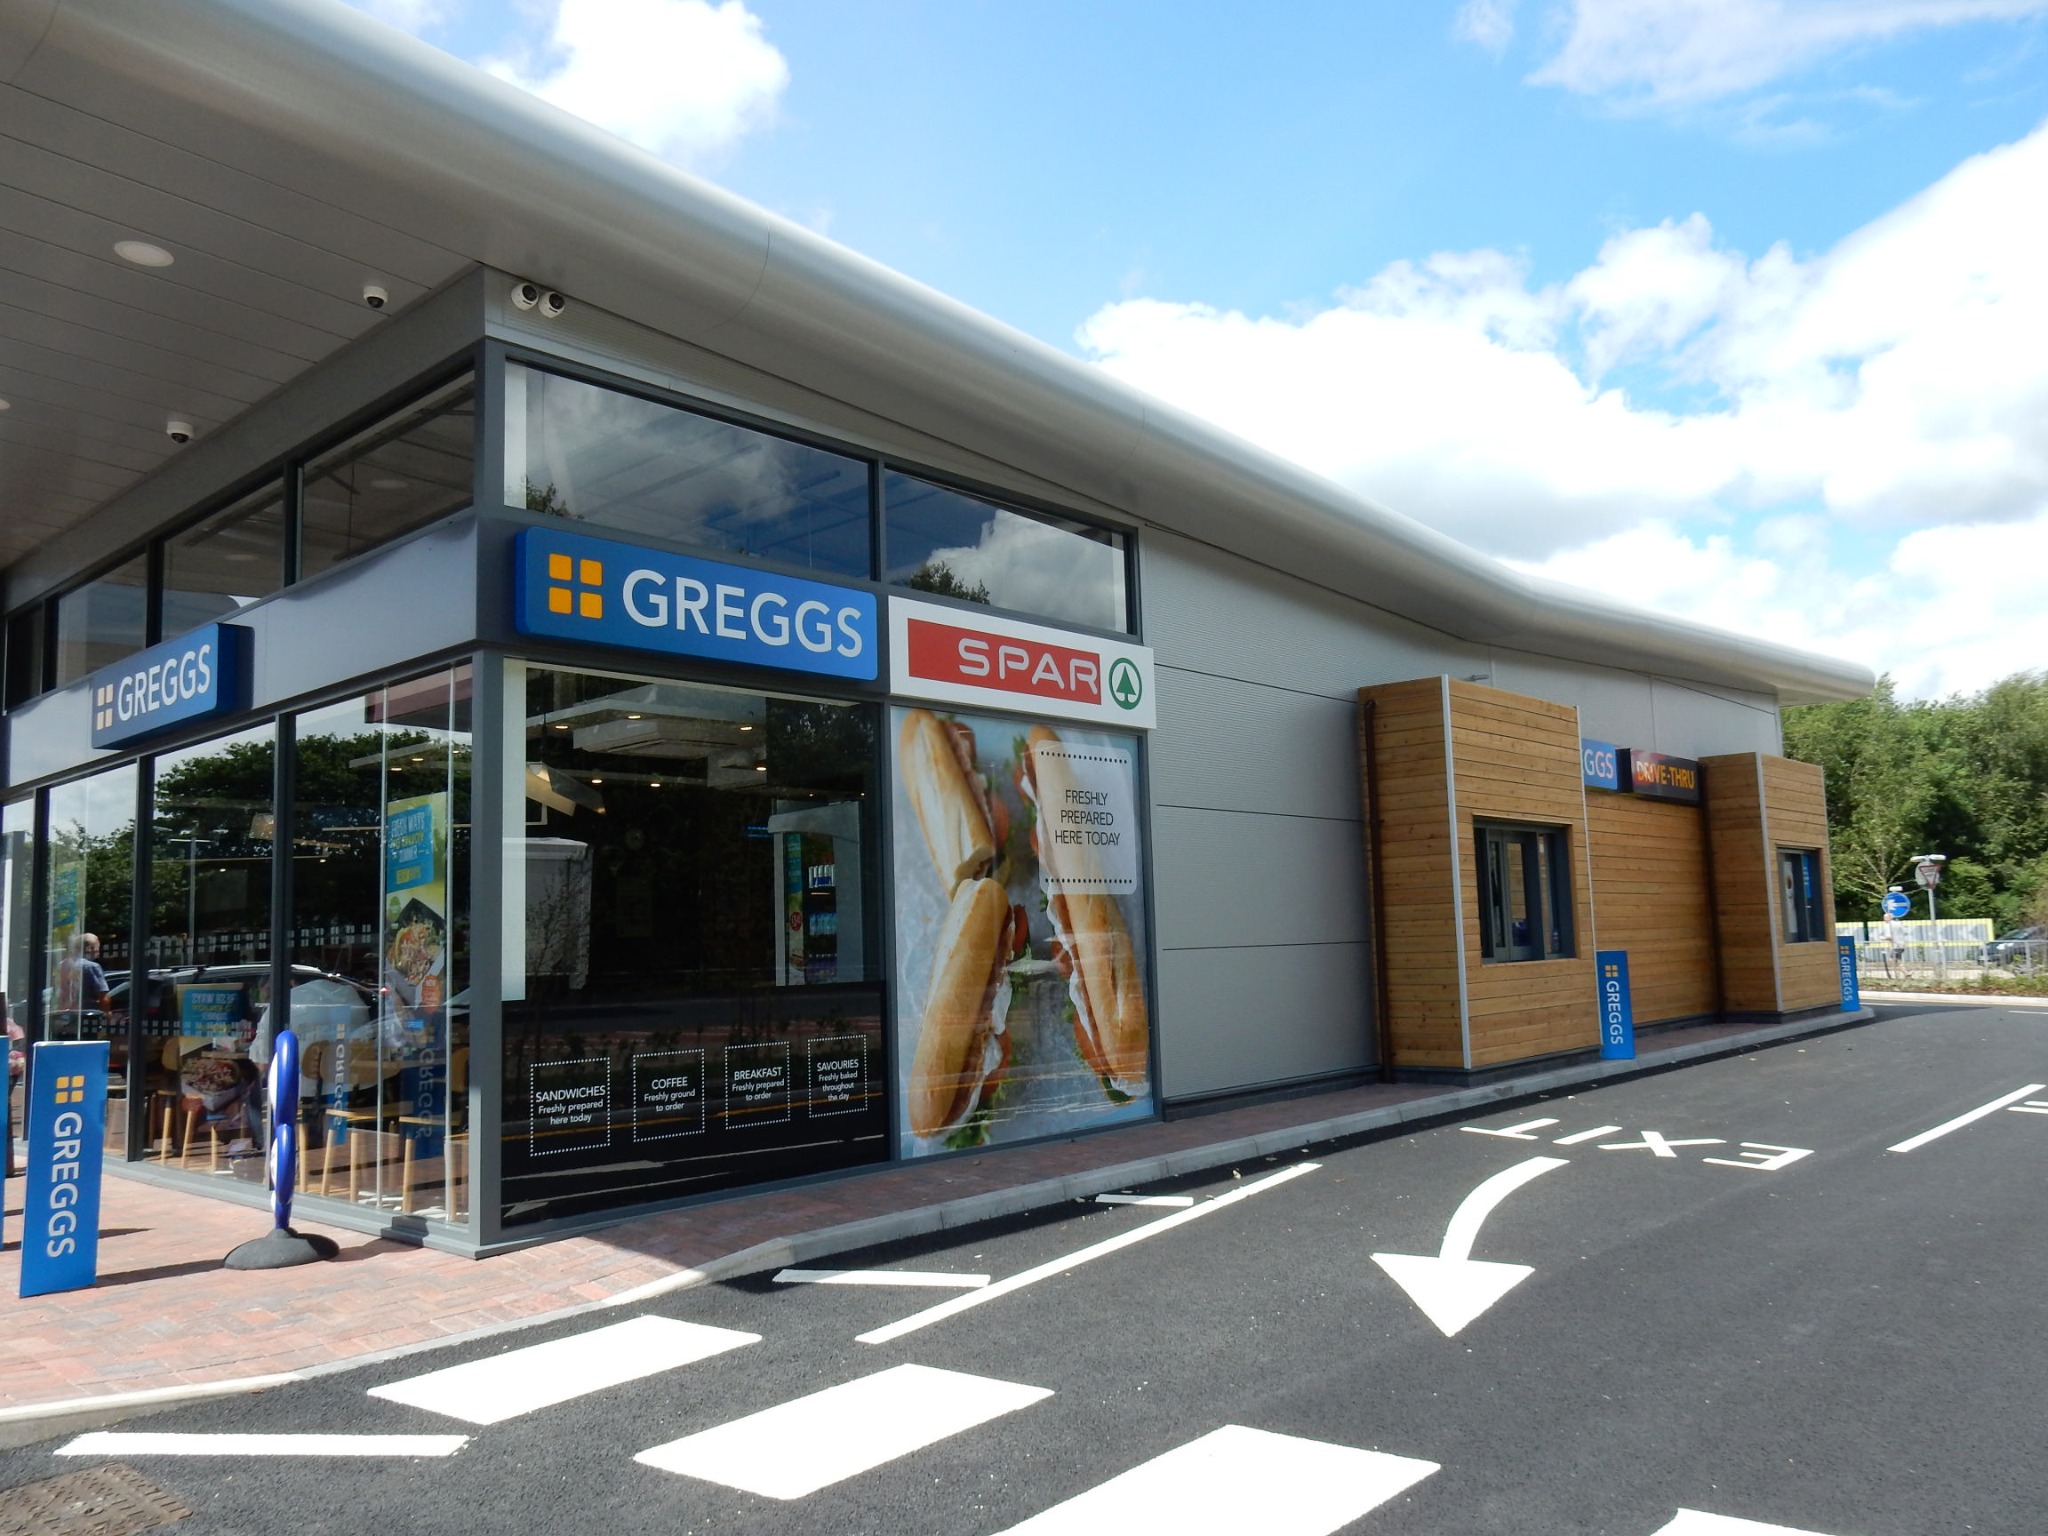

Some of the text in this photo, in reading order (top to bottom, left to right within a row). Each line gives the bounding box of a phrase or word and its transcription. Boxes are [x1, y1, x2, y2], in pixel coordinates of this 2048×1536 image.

[622, 569, 863, 658] GREGGS
[958, 637, 1098, 695] SPAR
[118, 644, 211, 721] GREGGS
[1582, 749, 1614, 779] GGS
[1636, 760, 1695, 790] DRIVE-THRU
[1065, 789, 1108, 806] FRESHLY
[1060, 809, 1114, 826] PREPARED
[1055, 830, 1120, 846] HERE TODAY
[1840, 956, 1853, 1001] GREGGS
[1606, 980, 1624, 1045] GREGGS
[816, 1058, 859, 1072] SAVOURIES
[734, 1066, 782, 1081] BREAKFAST
[818, 1070, 858, 1082] Freshly baked
[651, 1076, 688, 1090] COFFEE
[731, 1078, 785, 1092] Freshly prepared
[822, 1082, 854, 1093] throughout
[535, 1085, 606, 1103] SANDWICHES
[644, 1088, 696, 1102] Freshly ground
[754, 1091, 771, 1100] order
[827, 1092, 849, 1101] the day
[538, 1099, 604, 1114] Freshly prepared
[655, 1101, 685, 1112] to order
[550, 1113, 592, 1125] here today
[1460, 1118, 1815, 1171] EXIT
[46, 1111, 83, 1258] GREGGS
